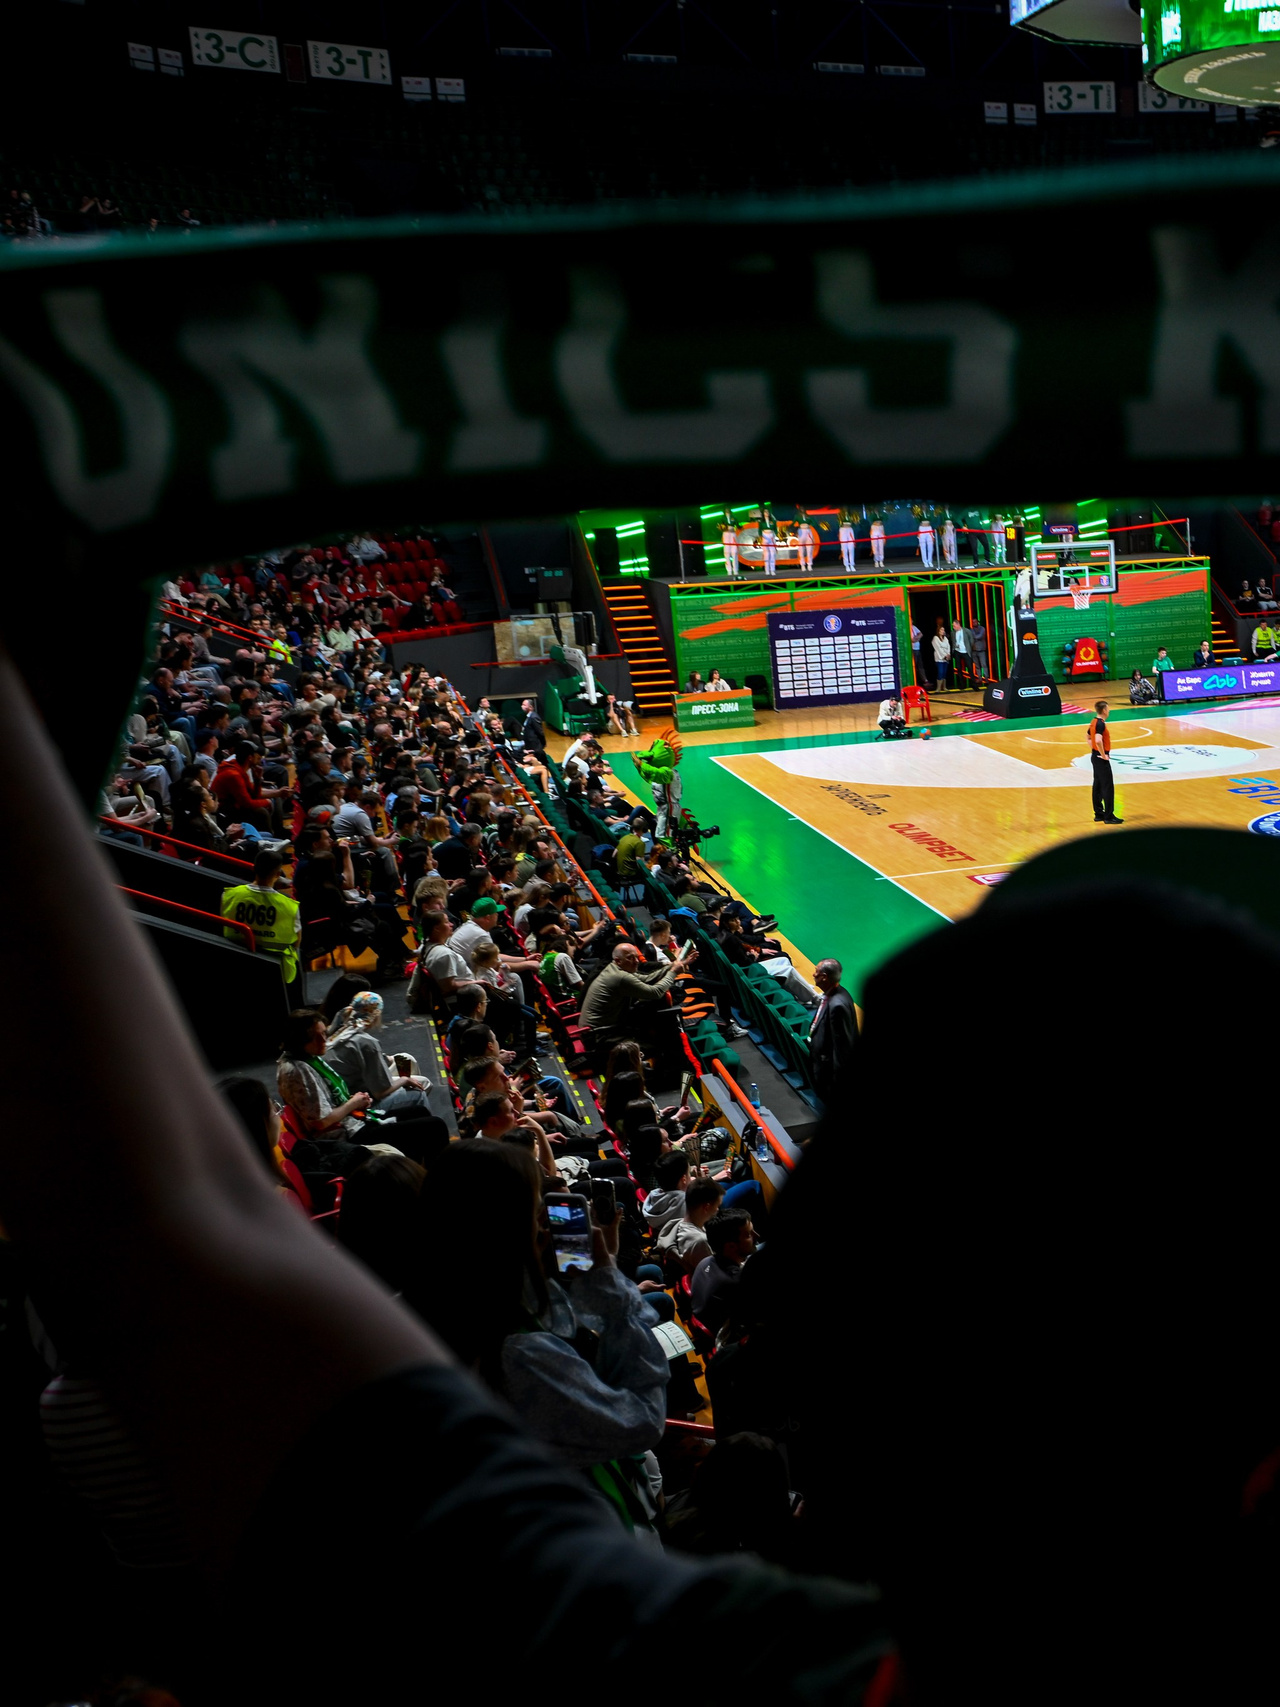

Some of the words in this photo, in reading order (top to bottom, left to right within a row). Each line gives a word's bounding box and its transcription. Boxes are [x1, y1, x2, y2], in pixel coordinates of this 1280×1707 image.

[204, 32, 267, 68] 3-С
[326, 46, 372, 79] 3-Т
[1056, 85, 1104, 111] 3-Т
[692, 702, 739, 715] ПРЕСС-ЗОНА
[888, 822, 976, 863] OLIMPBET
[236, 902, 276, 927] 8069
